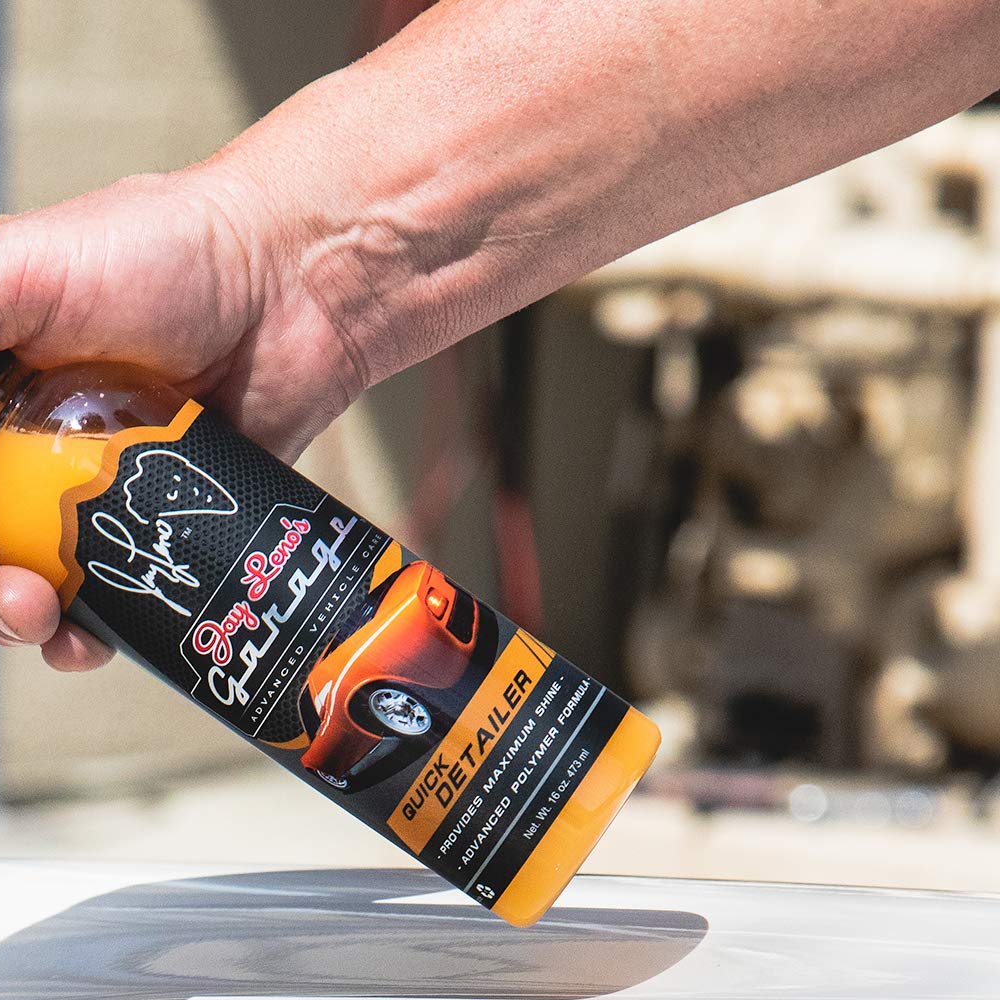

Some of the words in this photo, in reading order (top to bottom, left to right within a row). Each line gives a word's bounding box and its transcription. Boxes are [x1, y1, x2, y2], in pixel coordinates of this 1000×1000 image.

[193, 600, 260, 667] Jay
[240, 516, 311, 601] Leno's
[207, 515, 358, 706] Garage
[251, 645, 304, 723] ADVANCED
[309, 564, 359, 633] VEHICLE
[362, 533, 383, 558] CARE
[402, 752, 450, 821] QUICK
[434, 669, 532, 810] DETAILER
[440, 795, 484, 856] PROVIDES
[483, 718, 537, 794] MAXIMUM
[534, 680, 562, 718] SHINE
[461, 796, 511, 866] ADVANCED
[510, 726, 559, 794] POLYMER
[523, 822, 542, 840] Net.
[535, 806, 552, 821] Wt.
[548, 791, 561, 804] 16
[558, 779, 571, 793] oz.
[566, 759, 582, 778] 473
[578, 748, 590, 762] ml
